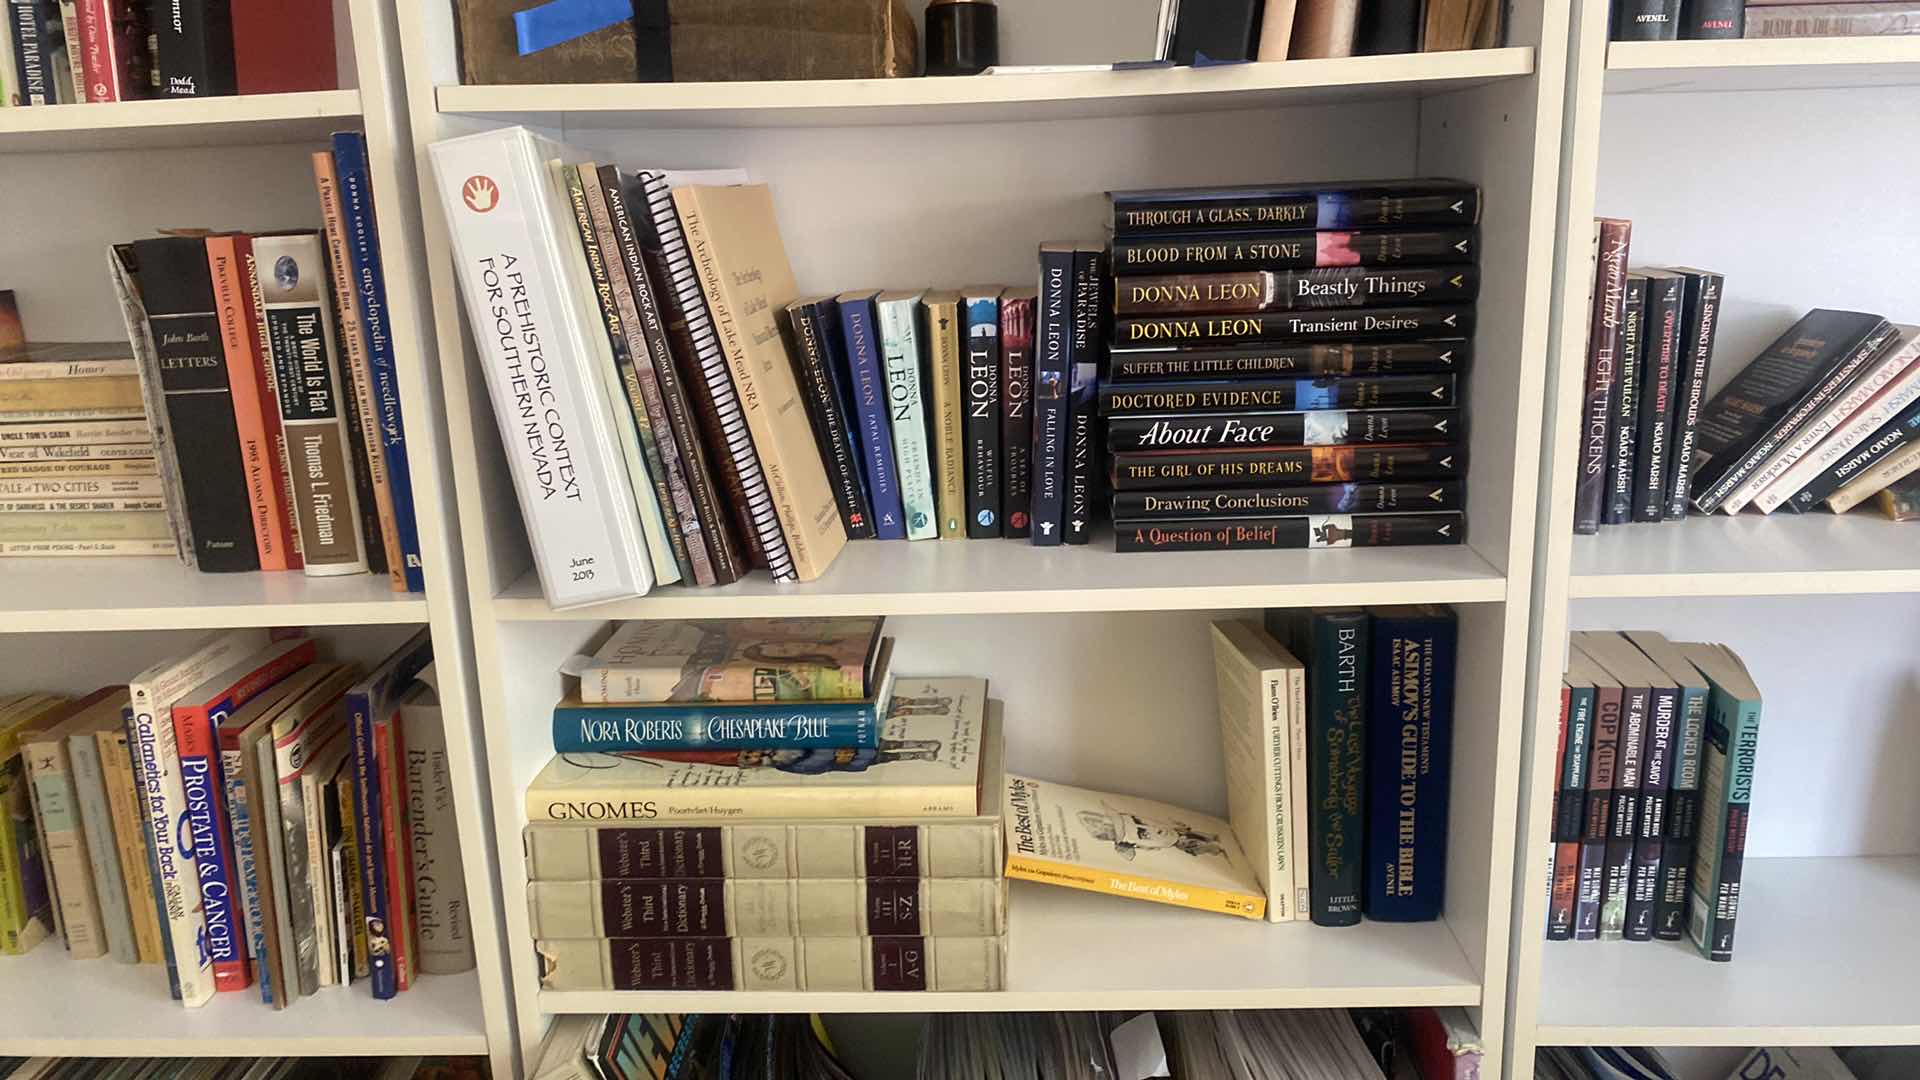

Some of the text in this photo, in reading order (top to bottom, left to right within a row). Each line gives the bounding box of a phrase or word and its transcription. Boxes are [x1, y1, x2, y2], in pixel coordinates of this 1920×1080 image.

[1636, 15, 1668, 23] AVENEL
[17, 6, 44, 92] HOTEL PARADISE
[607, 186, 632, 242] AMERICAN
[1128, 209, 1191, 226] THROUGH
[1197, 210, 1204, 223] A
[1258, 206, 1308, 221] DARKLY
[624, 242, 644, 282] INDIAN
[1128, 244, 1301, 263] BLOOD FROM A STONE
[635, 282, 652, 309] ROCK
[1132, 276, 1426, 303] DONNA LEON Beastly Things
[1601, 239, 1627, 327] Ngaio Marsh
[643, 309, 658, 332] ART
[684, 211, 761, 410] The Archeology of Lake Mead NRA
[1046, 268, 1062, 360] DONNA LEON
[1130, 316, 1418, 339] DONNA LEON Transient Desires
[161, 357, 217, 369] LETTERS
[297, 314, 328, 413] The World Is Flat
[357, 266, 387, 352] encyclopedia
[376, 371, 403, 446] needlework
[479, 257, 557, 501] FOR SOUTHERN NEVADA
[500, 253, 582, 502] A PREHISTORIC CONTEXT
[652, 338, 670, 374] VOLUME
[850, 313, 868, 365] DONNA
[859, 370, 876, 406] LEON
[868, 413, 880, 445] FATAL
[1123, 357, 1296, 374] SUFFER THE LITTLE CHILDREN
[1621, 311, 1636, 416] NIGHT AT THE VULCAN
[1658, 365, 1668, 380] TO
[1686, 303, 1714, 426] SINGING IN THE SHROUDS
[887, 354, 911, 422] LEON
[906, 367, 918, 406] DONNA
[970, 350, 988, 418] LEON
[986, 364, 999, 403] DONNA
[1007, 351, 1023, 417] LEON
[1112, 391, 1280, 408] DOCTORED EVIDENCE
[1655, 381, 1666, 413] DEATH
[1139, 420, 1274, 445] About Face
[1586, 348, 1612, 474] LIGHT THICKENS
[245, 439, 259, 462] 1995
[304, 435, 323, 479] Thomas
[1043, 408, 1056, 498] FALLING IN LOVE
[1073, 415, 1086, 513] DONNA LEON
[1129, 461, 1302, 477] THE GIRL OF HIS DREAMS
[1616, 425, 1629, 492] NGAIO MARSH
[1648, 421, 1663, 489] NGAIO MARSH
[1674, 430, 1693, 498] NGAIO MARSH
[1835, 427, 1904, 478] NGAIO MARSH
[312, 494, 334, 545] Friedman
[1145, 493, 1309, 511] Drawing Conclusions
[1136, 526, 1277, 544] A Question of Belief
[570, 556, 594, 568] June
[573, 570, 594, 581] 2013
[1338, 628, 1354, 692] BARTH
[581, 714, 829, 742] NORA ROBERTS CHESAPEAKE BLUE
[1687, 695, 1702, 715] THE
[1597, 701, 1619, 783] COP KILLER
[1623, 693, 1643, 788] THE ABOMINABLE MAN
[1647, 695, 1673, 784] MURDER AT SAVOY
[1682, 718, 1699, 756] LOCKED
[1731, 721, 1759, 801] TERRORISTS
[1397, 639, 1419, 896] ASIMOV'S GUIDE TO THE BIBLE
[1679, 758, 1696, 788] ROOM
[136, 712, 178, 879] Callanetics for Your Back
[548, 802, 657, 820] GNOMES
[181, 757, 236, 959] PROSTATE & CANCER
[407, 748, 439, 939] Bartender's Guide
[1110, 879, 1188, 900] The Best of Myles
